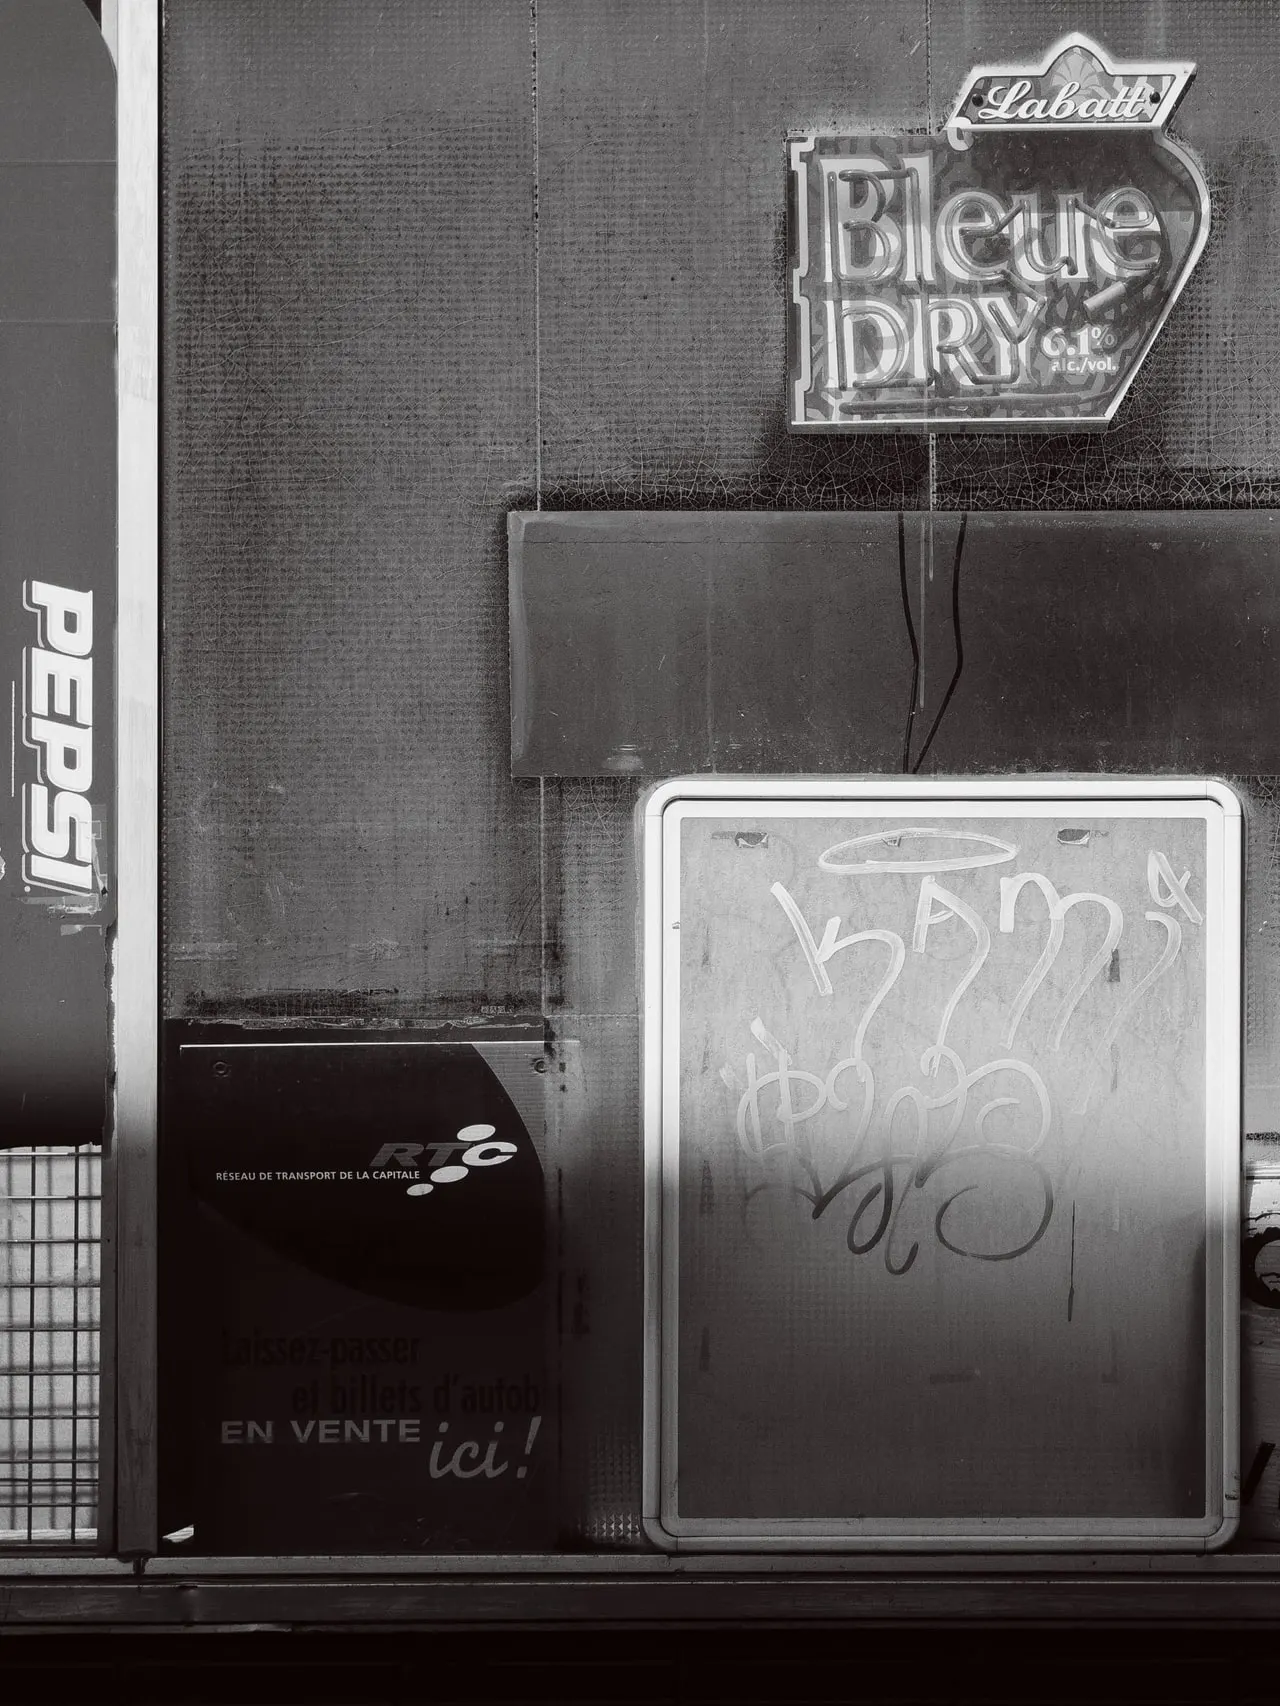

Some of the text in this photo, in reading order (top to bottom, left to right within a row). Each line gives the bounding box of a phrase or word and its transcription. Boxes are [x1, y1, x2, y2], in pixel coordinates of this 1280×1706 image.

[978, 81, 1147, 120] Labatt
[820, 154, 1165, 284] Bleue
[824, 294, 1050, 390] DRY
[1041, 323, 1116, 358] 6.1%
[1050, 357, 1119, 373] alc./vol.
[22, 579, 93, 896] PEPSI
[369, 1141, 518, 1167] RTC
[215, 1170, 421, 1182] RÉSEAU DE TRANSPORT DE LA CAPITALE
[221, 1420, 273, 1444] EN
[290, 1419, 421, 1443] VENTE
